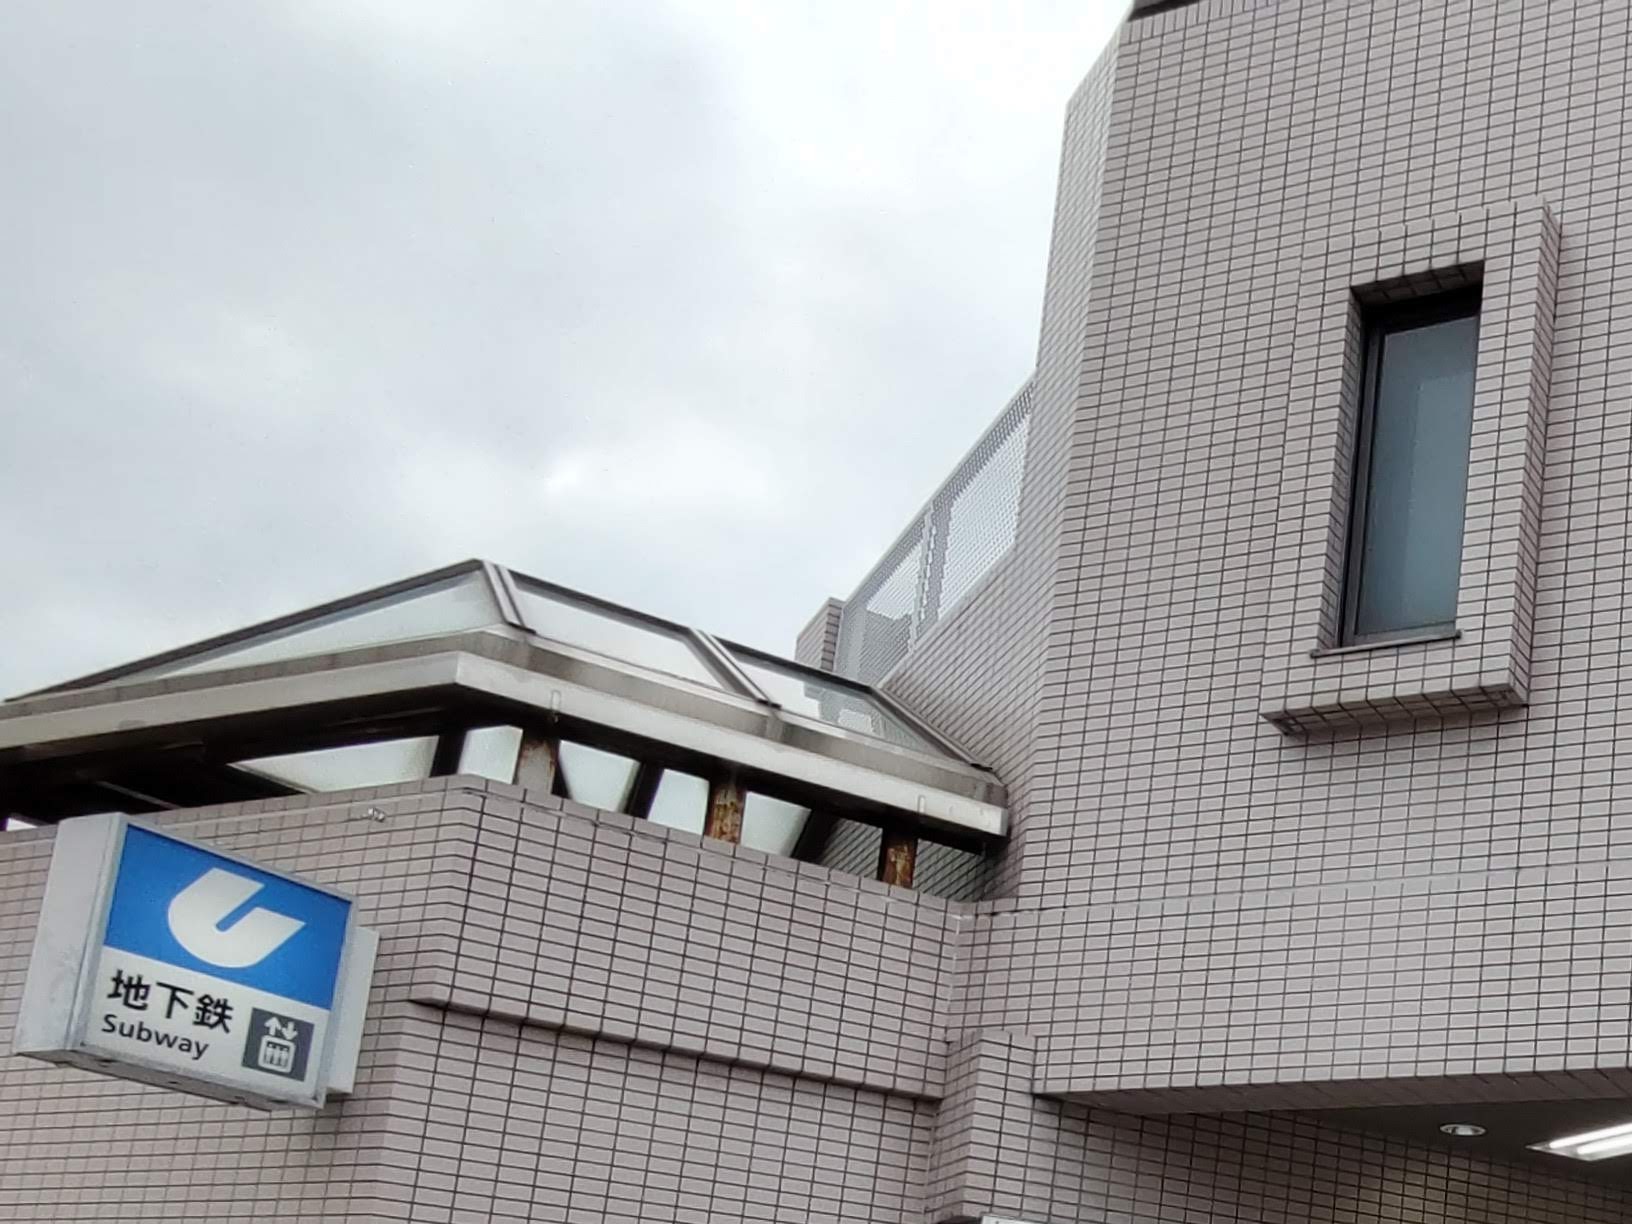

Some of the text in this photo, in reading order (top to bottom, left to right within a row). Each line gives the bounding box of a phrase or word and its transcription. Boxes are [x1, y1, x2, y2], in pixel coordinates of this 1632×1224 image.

[107, 969, 234, 1034] 地下鉄
[101, 1013, 209, 1060] Subway
